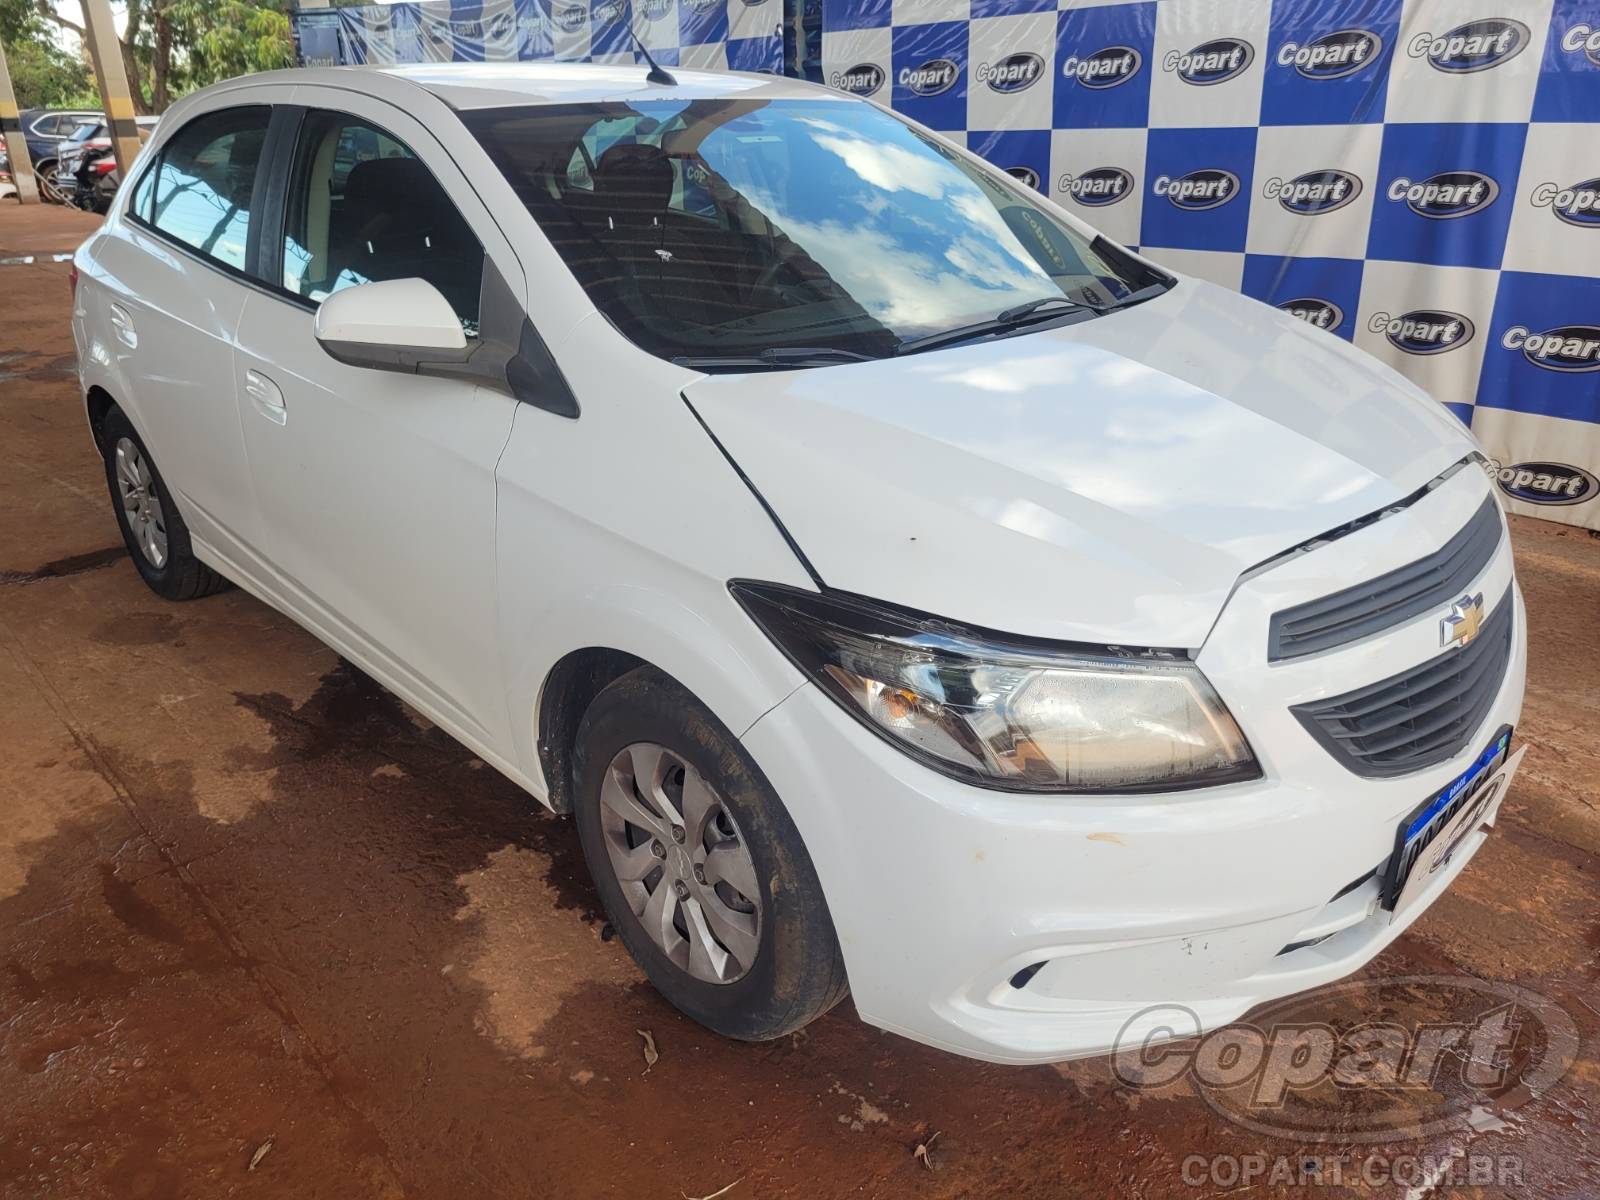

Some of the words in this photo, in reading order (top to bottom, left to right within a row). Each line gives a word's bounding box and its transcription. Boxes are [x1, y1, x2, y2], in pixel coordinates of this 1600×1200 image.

[1278, 34, 1370, 71] Copart
[1408, 24, 1516, 61] Copart
[976, 60, 1036, 87] Copart
[1063, 53, 1133, 82] Copart
[1163, 47, 1244, 75] Copart
[831, 71, 877, 91] Copart
[899, 67, 953, 89] Copart
[1058, 174, 1125, 197] Copart
[1153, 176, 1230, 204] Copart
[1263, 177, 1347, 205] Copart
[1387, 178, 1486, 207] Copart
[1368, 312, 1459, 343] Copart
[1501, 326, 1600, 360] Copar
